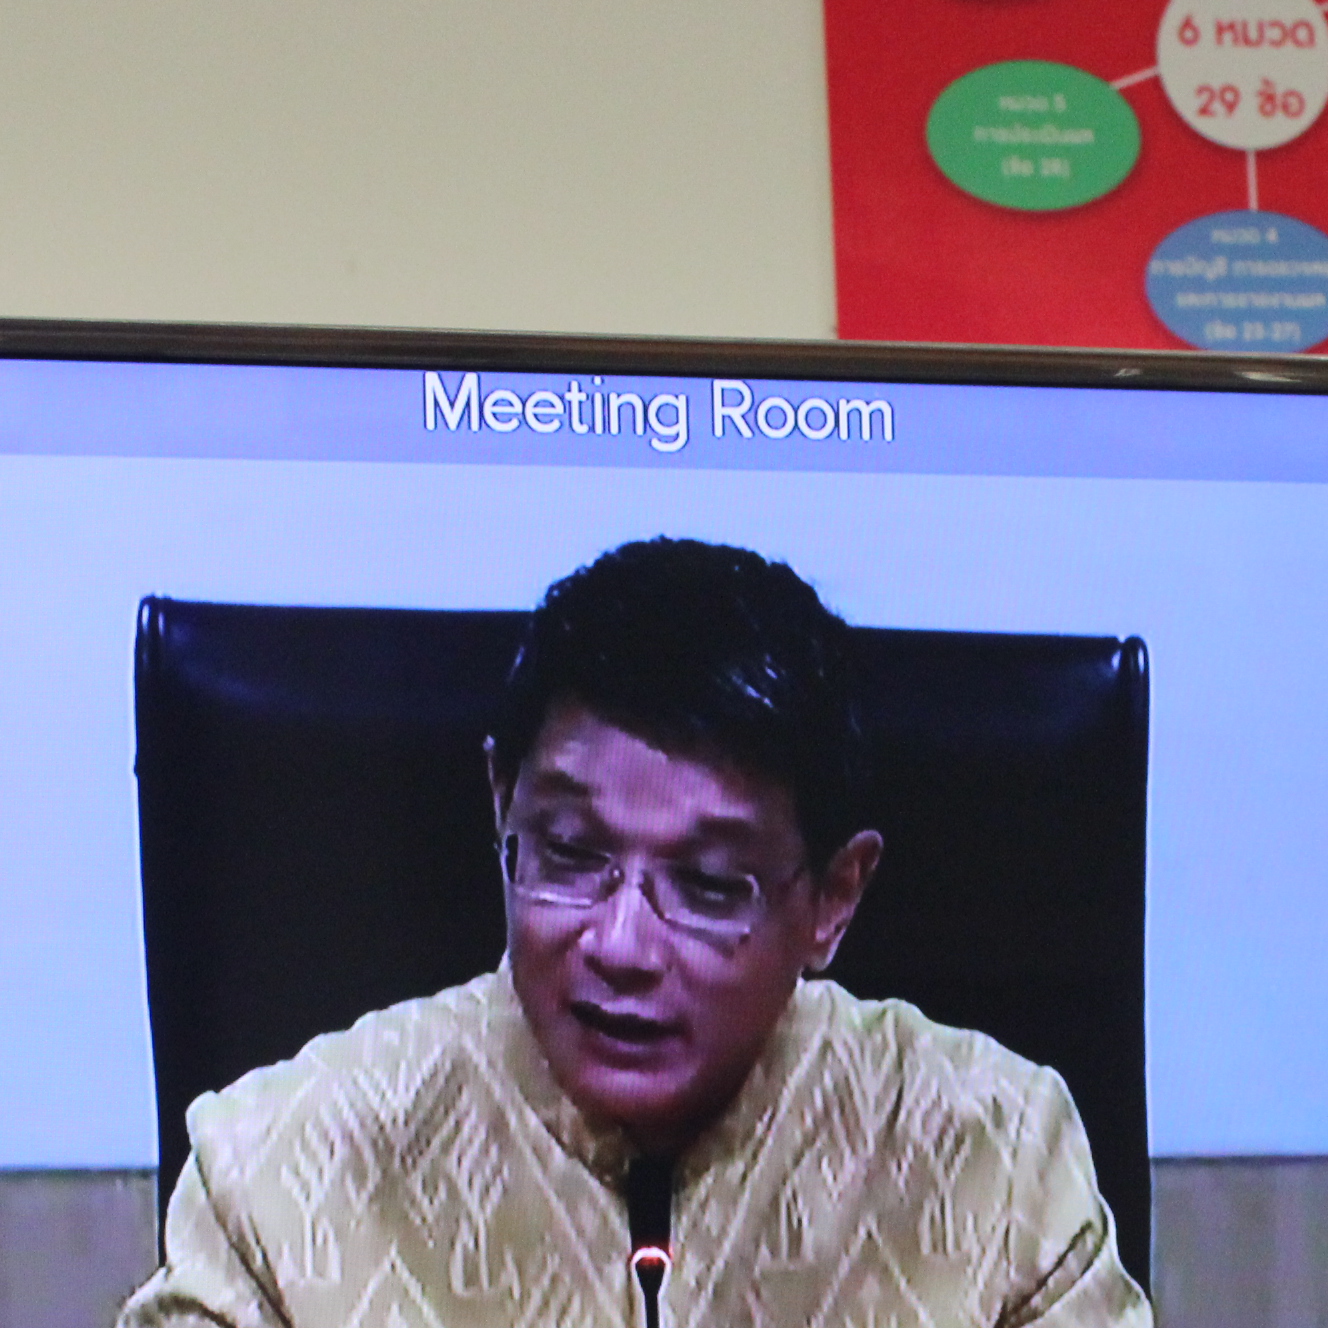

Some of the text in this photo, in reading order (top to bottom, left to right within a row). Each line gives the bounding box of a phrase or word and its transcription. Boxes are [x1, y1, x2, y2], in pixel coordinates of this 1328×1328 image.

[1177, 14, 1317, 49] 6 หมวด
[1194, 76, 1306, 119] 29 ข้อ
[423, 371, 895, 453] Meeting Room
